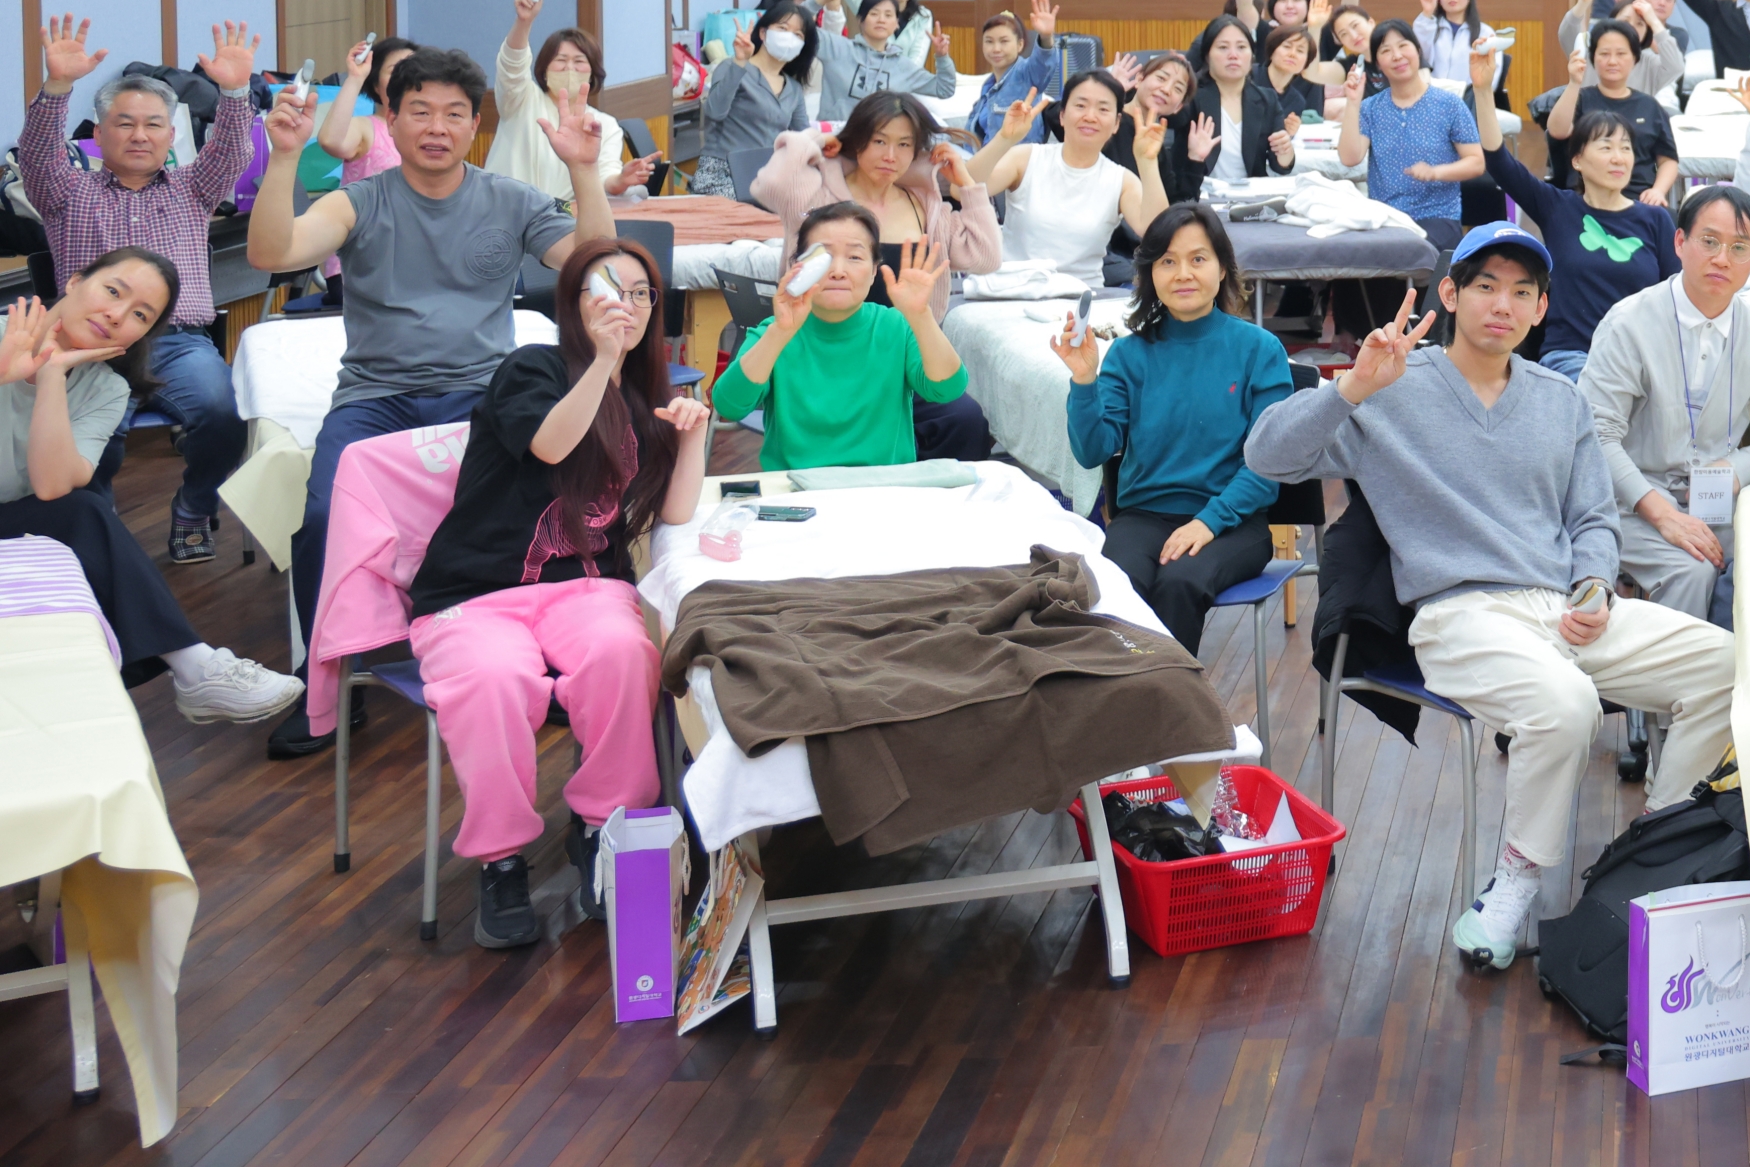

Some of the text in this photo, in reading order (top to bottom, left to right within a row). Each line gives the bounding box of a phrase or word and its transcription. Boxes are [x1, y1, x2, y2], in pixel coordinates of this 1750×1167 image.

[1685, 1025, 1750, 1044] WONKWANG
[1713, 1036, 1750, 1047] UNIVERSITY
[1685, 1042, 1750, 1062] 원광디지털대학교
